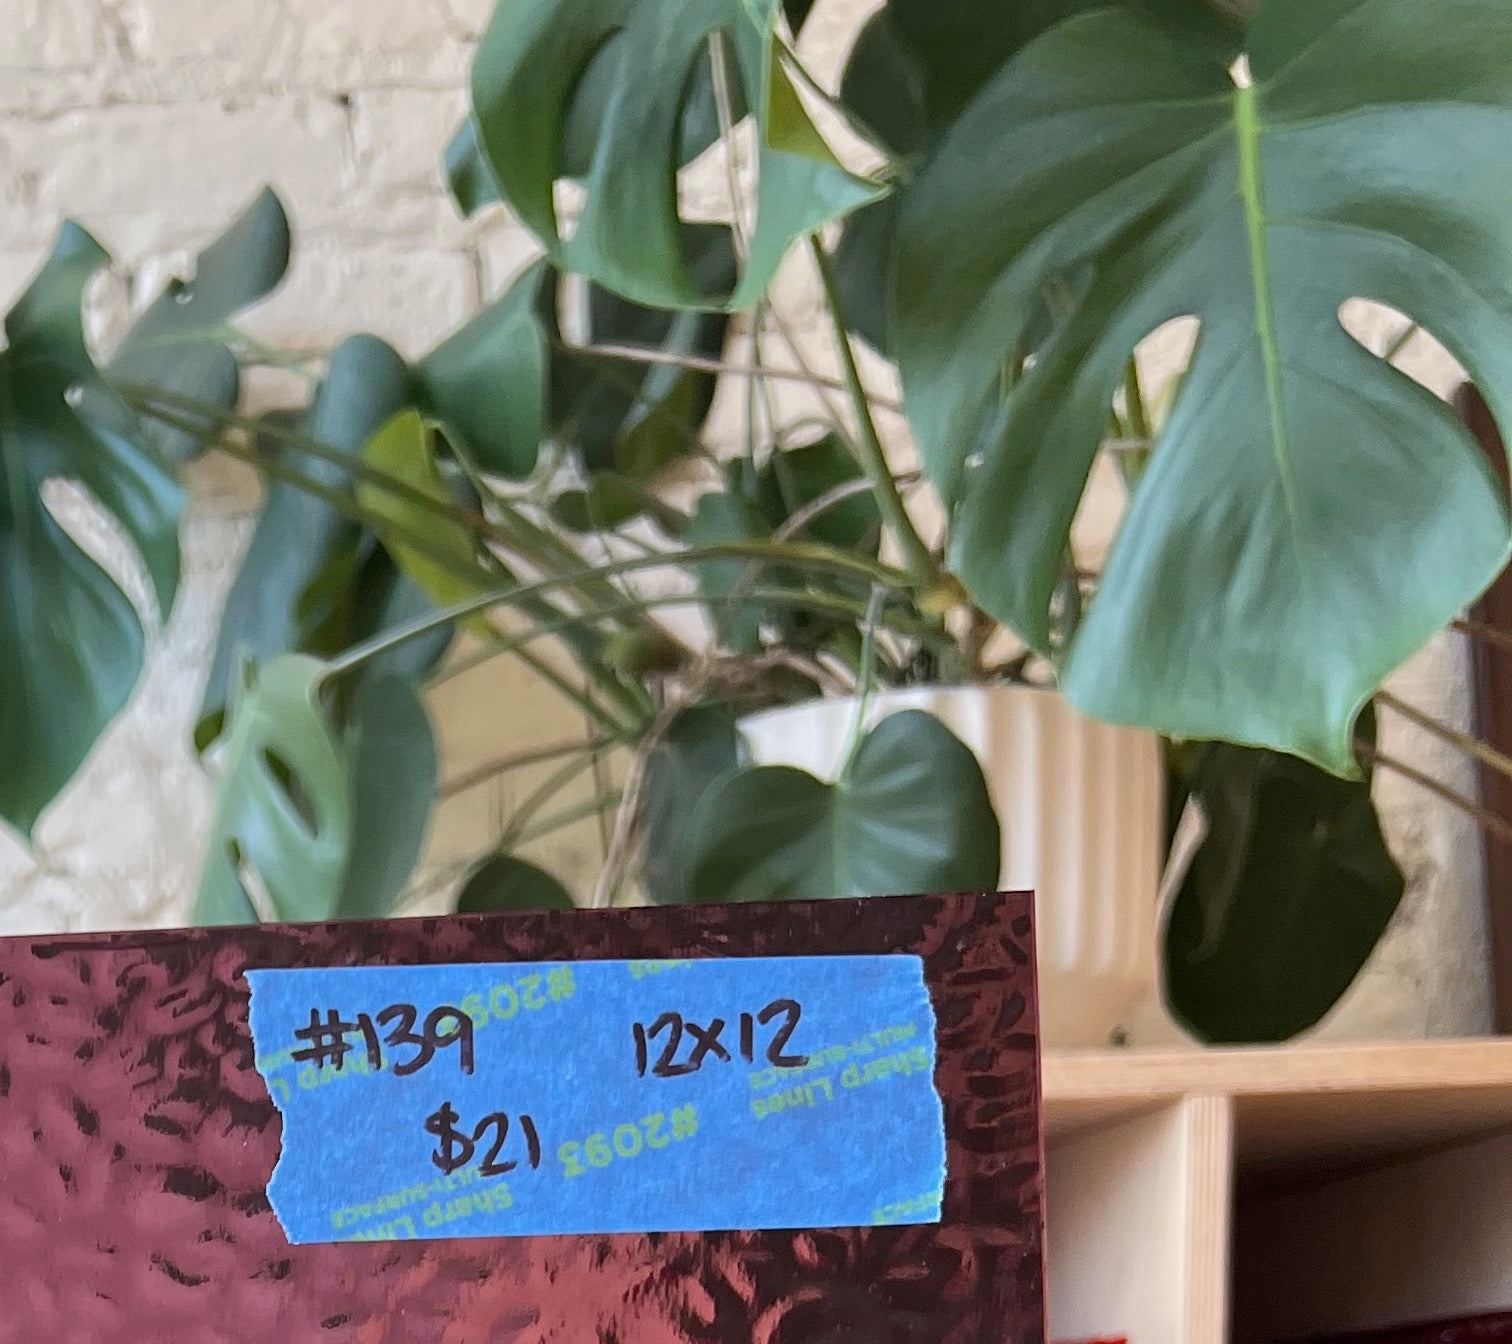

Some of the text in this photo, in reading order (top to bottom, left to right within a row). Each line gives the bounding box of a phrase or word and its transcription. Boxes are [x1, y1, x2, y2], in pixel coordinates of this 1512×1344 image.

[291, 1003, 475, 1077] #139
[751, 1044, 931, 1121] Sharp Lines
[424, 1100, 541, 1177] $21
[556, 1103, 700, 1180] #2093
[422, 1181, 513, 1228] Sharp
